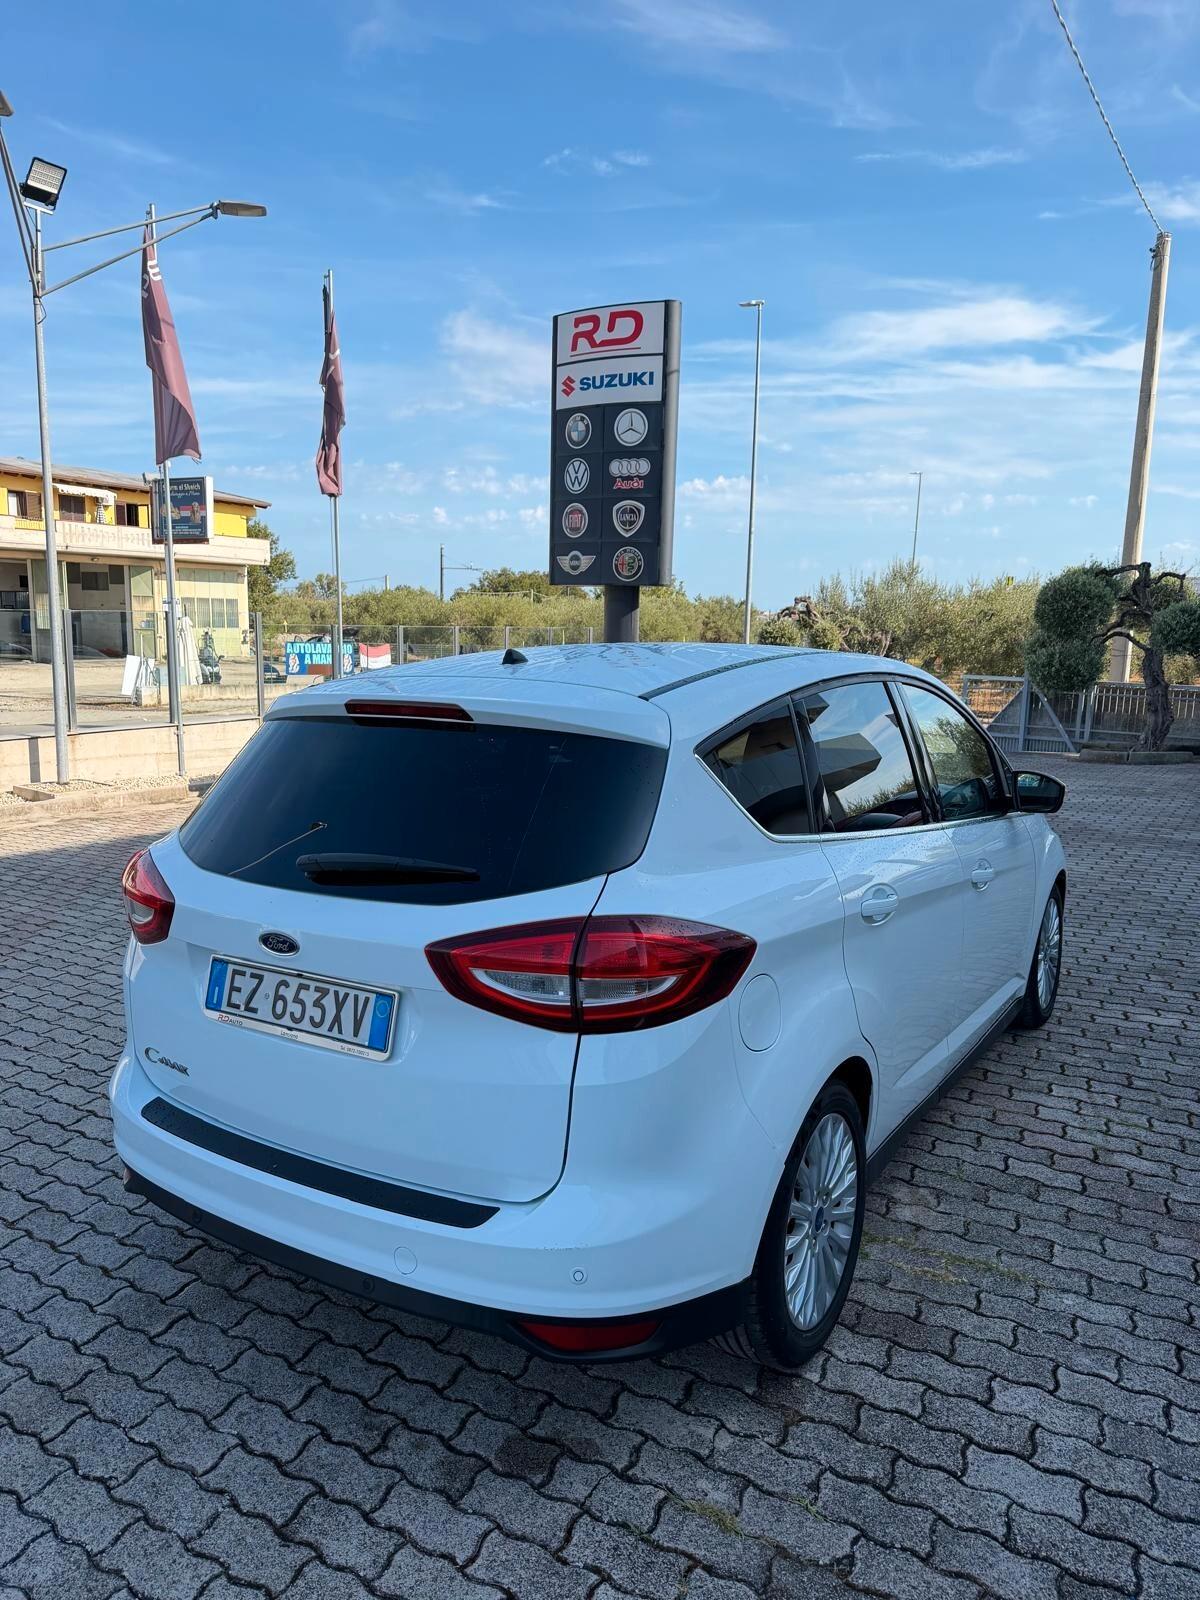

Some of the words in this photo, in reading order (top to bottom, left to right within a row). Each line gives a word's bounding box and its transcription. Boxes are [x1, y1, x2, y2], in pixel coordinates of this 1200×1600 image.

[571, 309, 644, 353] RD
[579, 371, 655, 392] SUZUKI
[613, 477, 644, 489] Audi
[286, 642, 353, 655] AUTOLAVAIO
[304, 653, 312, 665] A
[312, 653, 333, 665] MAN
[266, 934, 290, 953] Ford
[226, 967, 265, 1014] EZ
[271, 978, 371, 1038] 653XV
